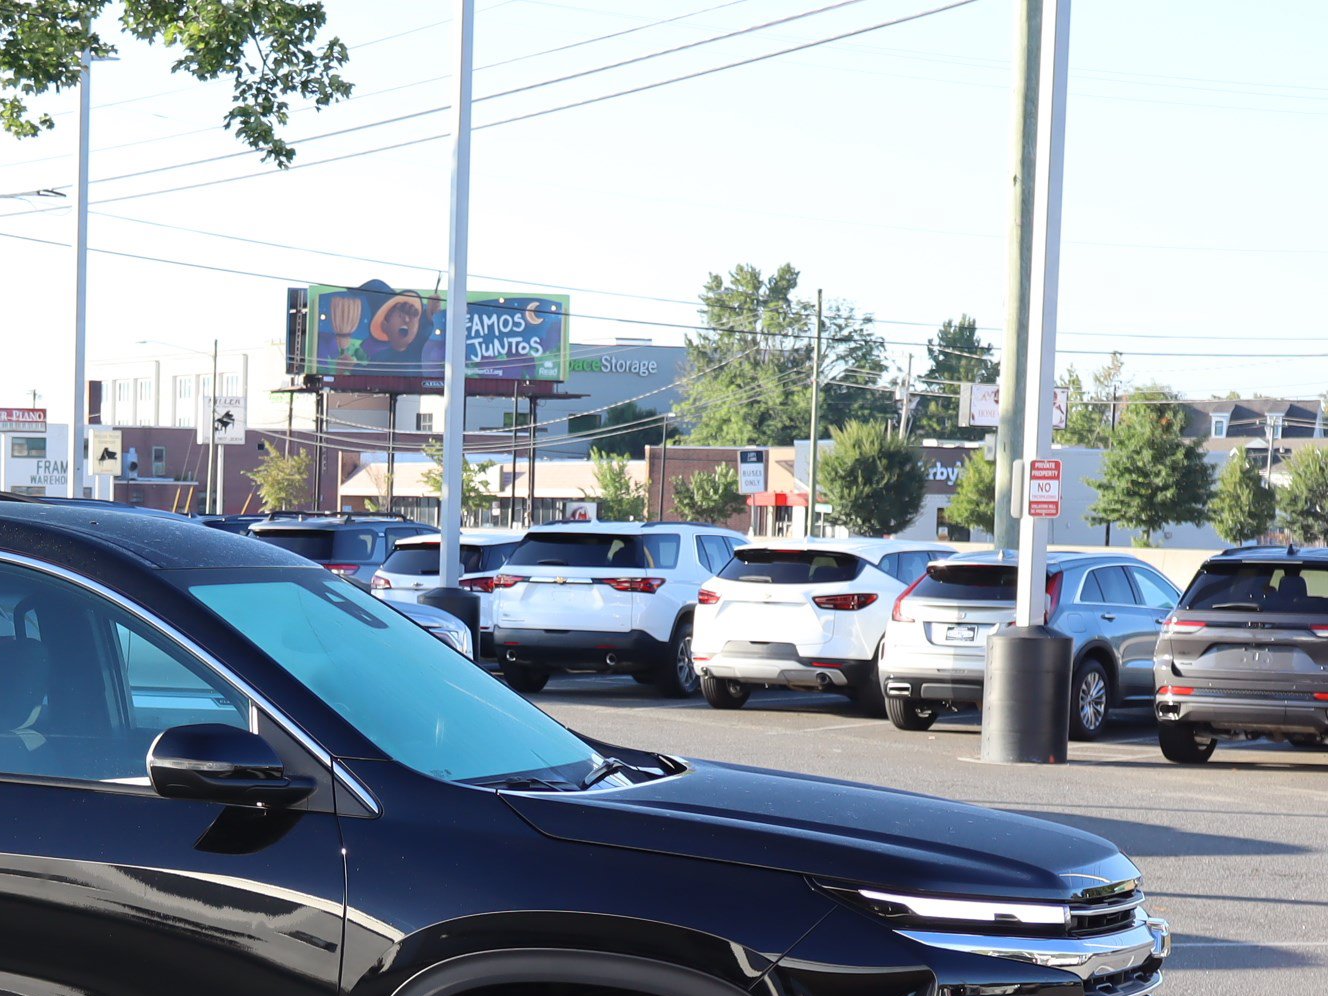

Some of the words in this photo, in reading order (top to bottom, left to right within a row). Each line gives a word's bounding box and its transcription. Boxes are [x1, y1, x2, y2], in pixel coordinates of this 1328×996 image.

[466, 337, 543, 362] JUNTOS
[13, 410, 44, 421] PIANO
[742, 470, 763, 478] BUSES
[1037, 482, 1052, 493] NO
